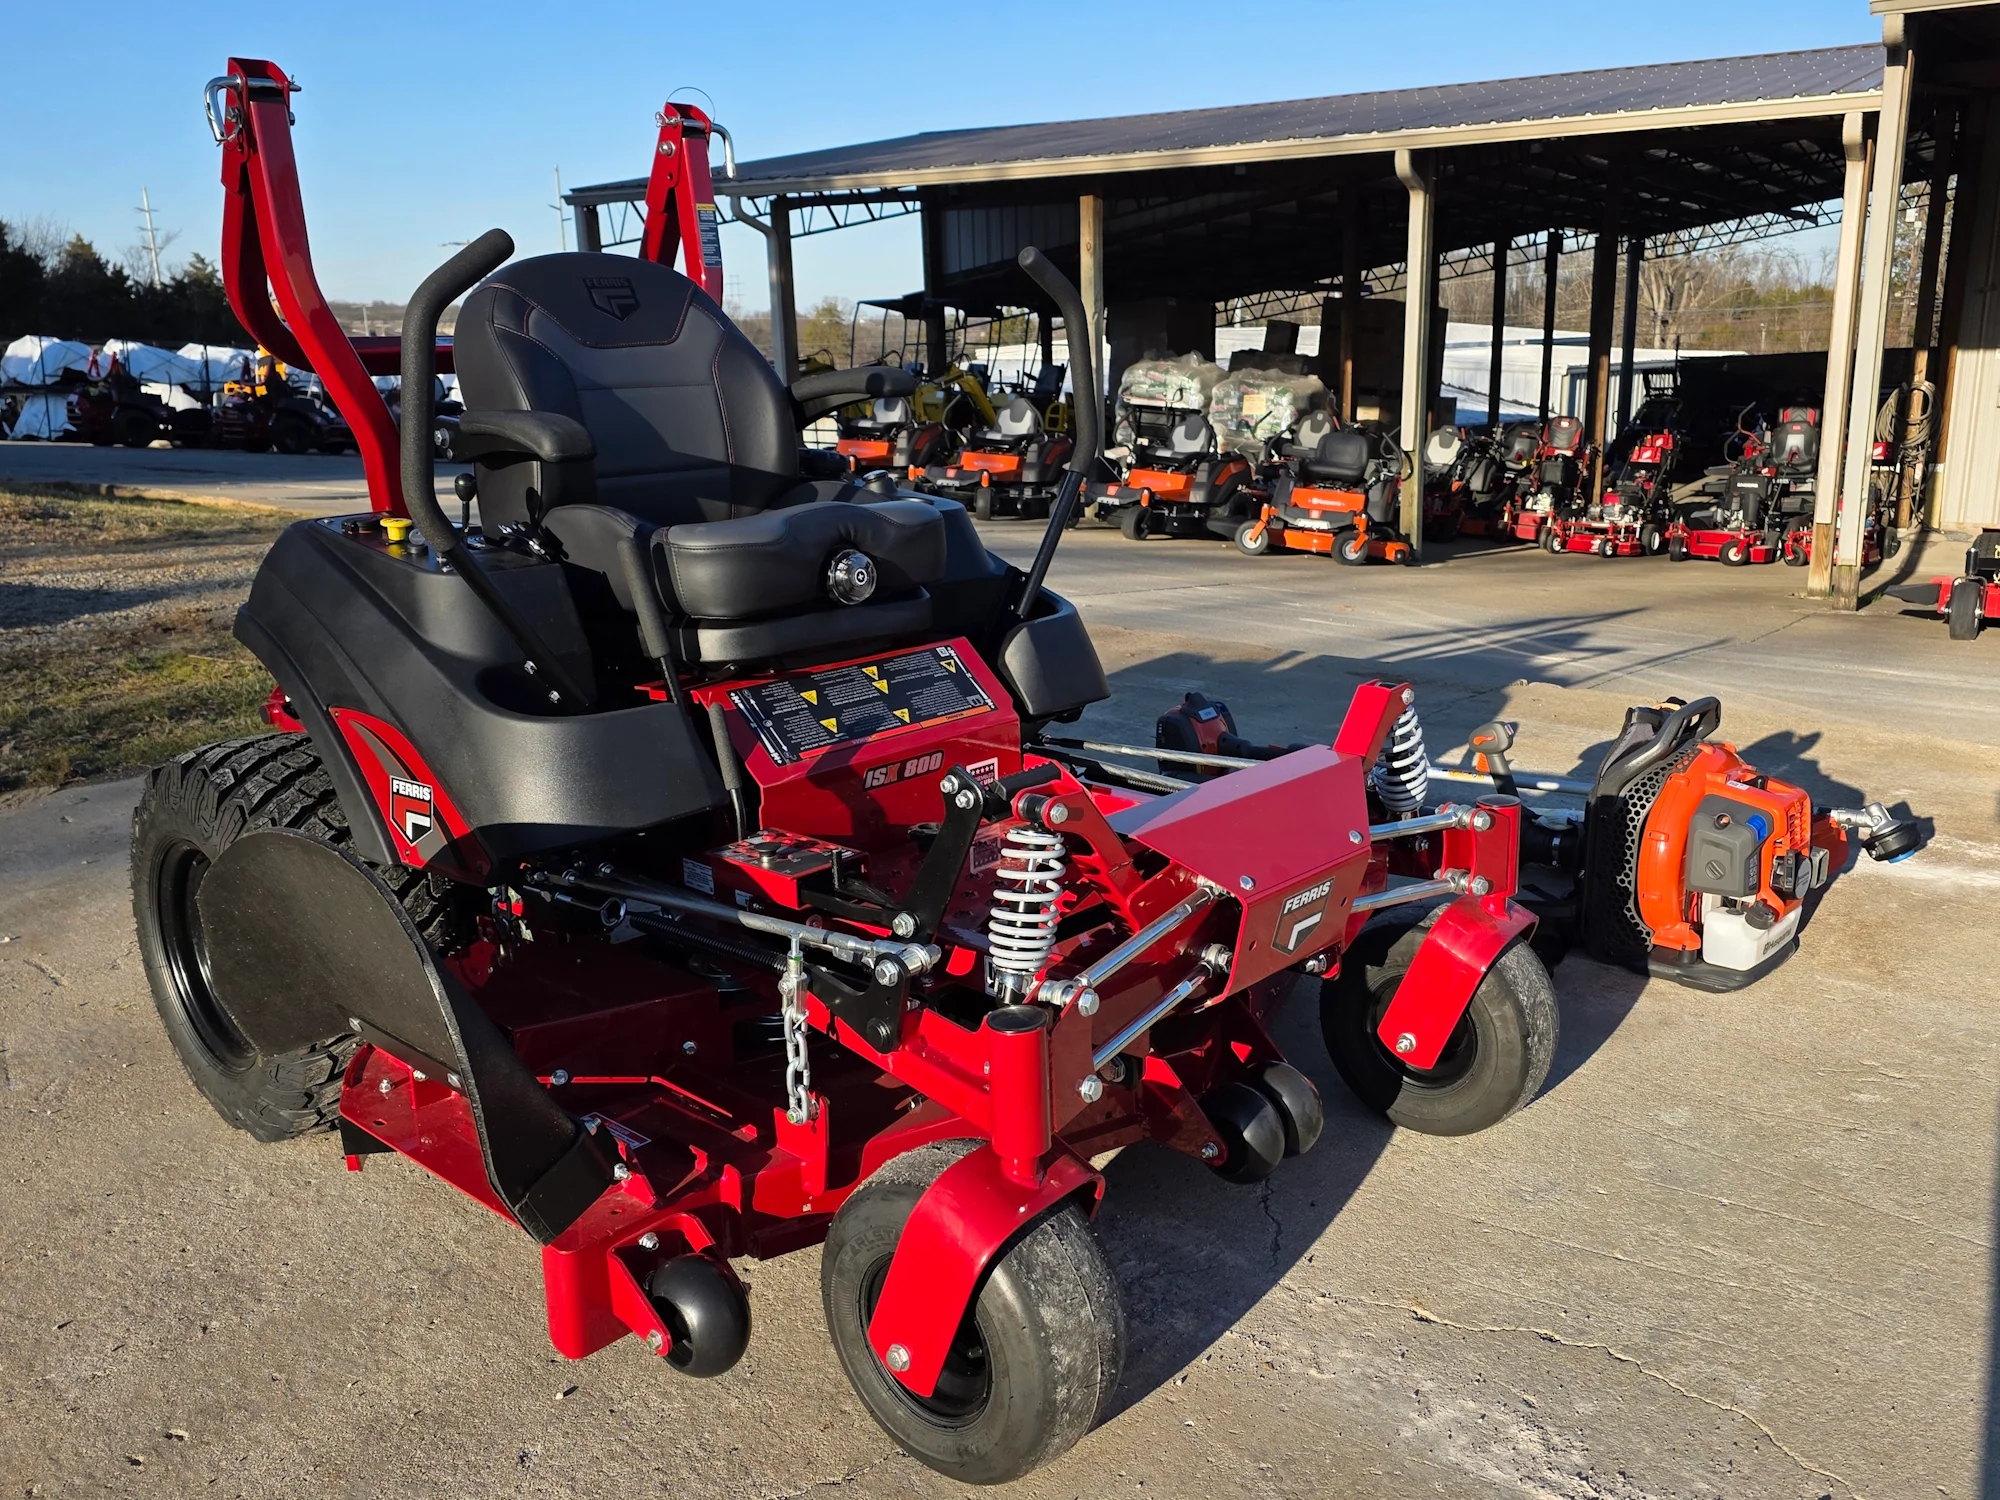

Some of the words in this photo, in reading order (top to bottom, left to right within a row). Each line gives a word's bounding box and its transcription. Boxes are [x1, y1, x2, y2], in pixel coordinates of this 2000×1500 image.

[585, 277, 629, 288] FERRIS
[864, 763, 901, 789] ISX
[904, 752, 943, 778] 800
[392, 779, 431, 801] FERRIS
[1283, 881, 1331, 914] FERRIS
